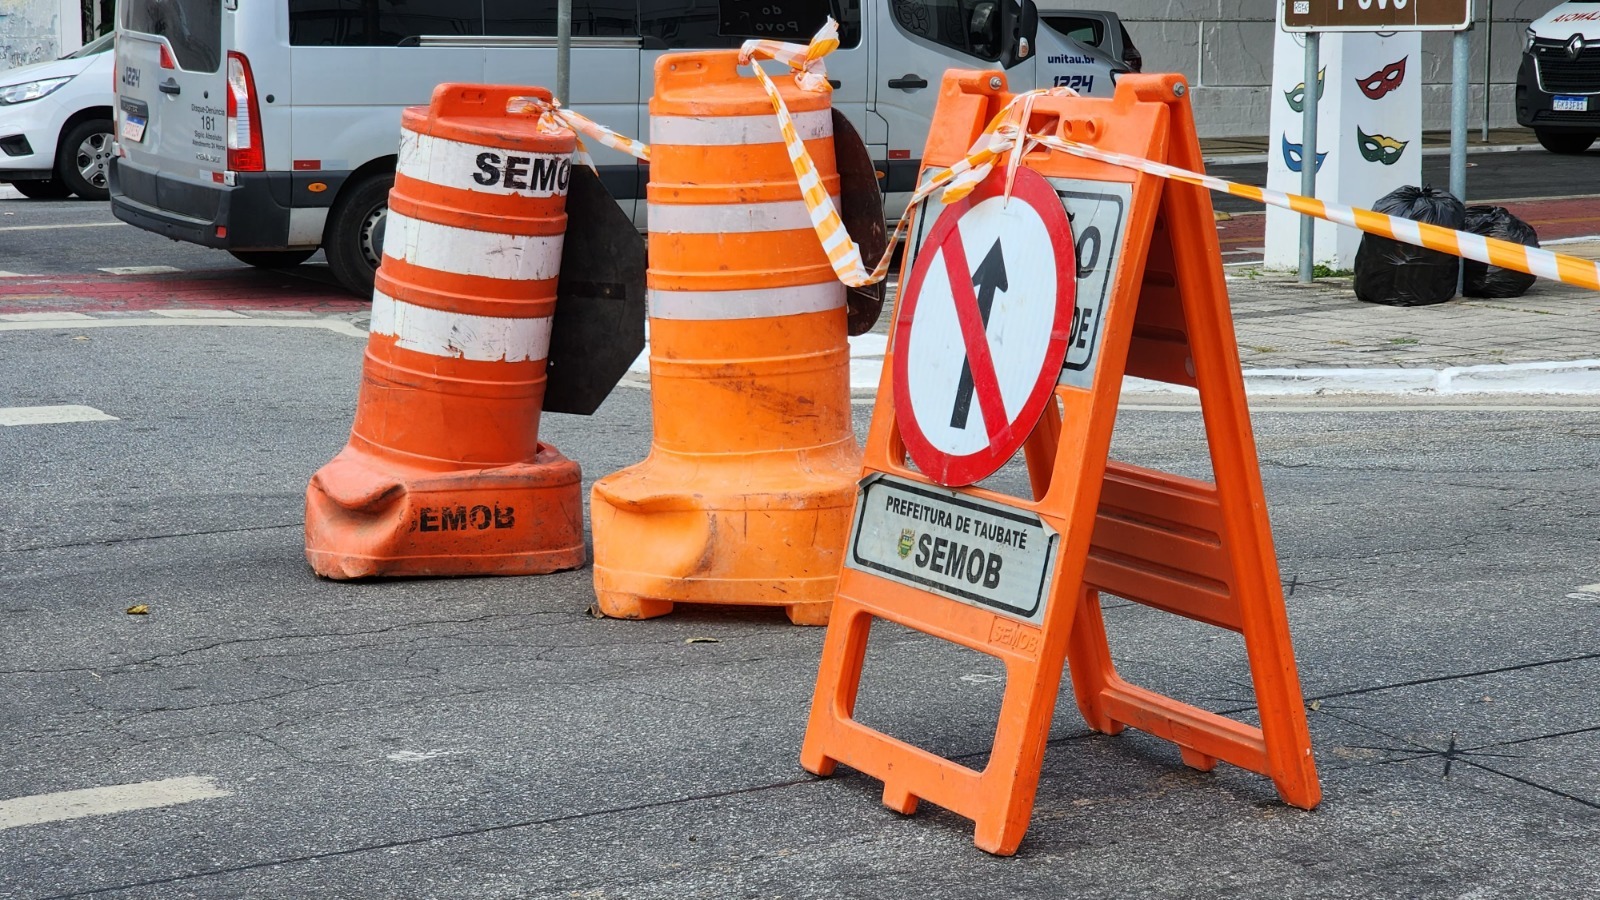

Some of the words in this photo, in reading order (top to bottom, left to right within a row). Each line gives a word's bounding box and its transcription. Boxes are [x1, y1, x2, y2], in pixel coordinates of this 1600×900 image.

[1047, 53, 1096, 65] unitau.br
[1053, 74, 1095, 93] 1224
[201, 115, 215, 131] 181
[885, 495, 952, 530] PREFEITURA
[955, 514, 971, 534] DE
[974, 519, 1028, 550] TAUBATÉ
[915, 533, 1003, 590] SEMOB
[994, 625, 1039, 653] SEMOB
